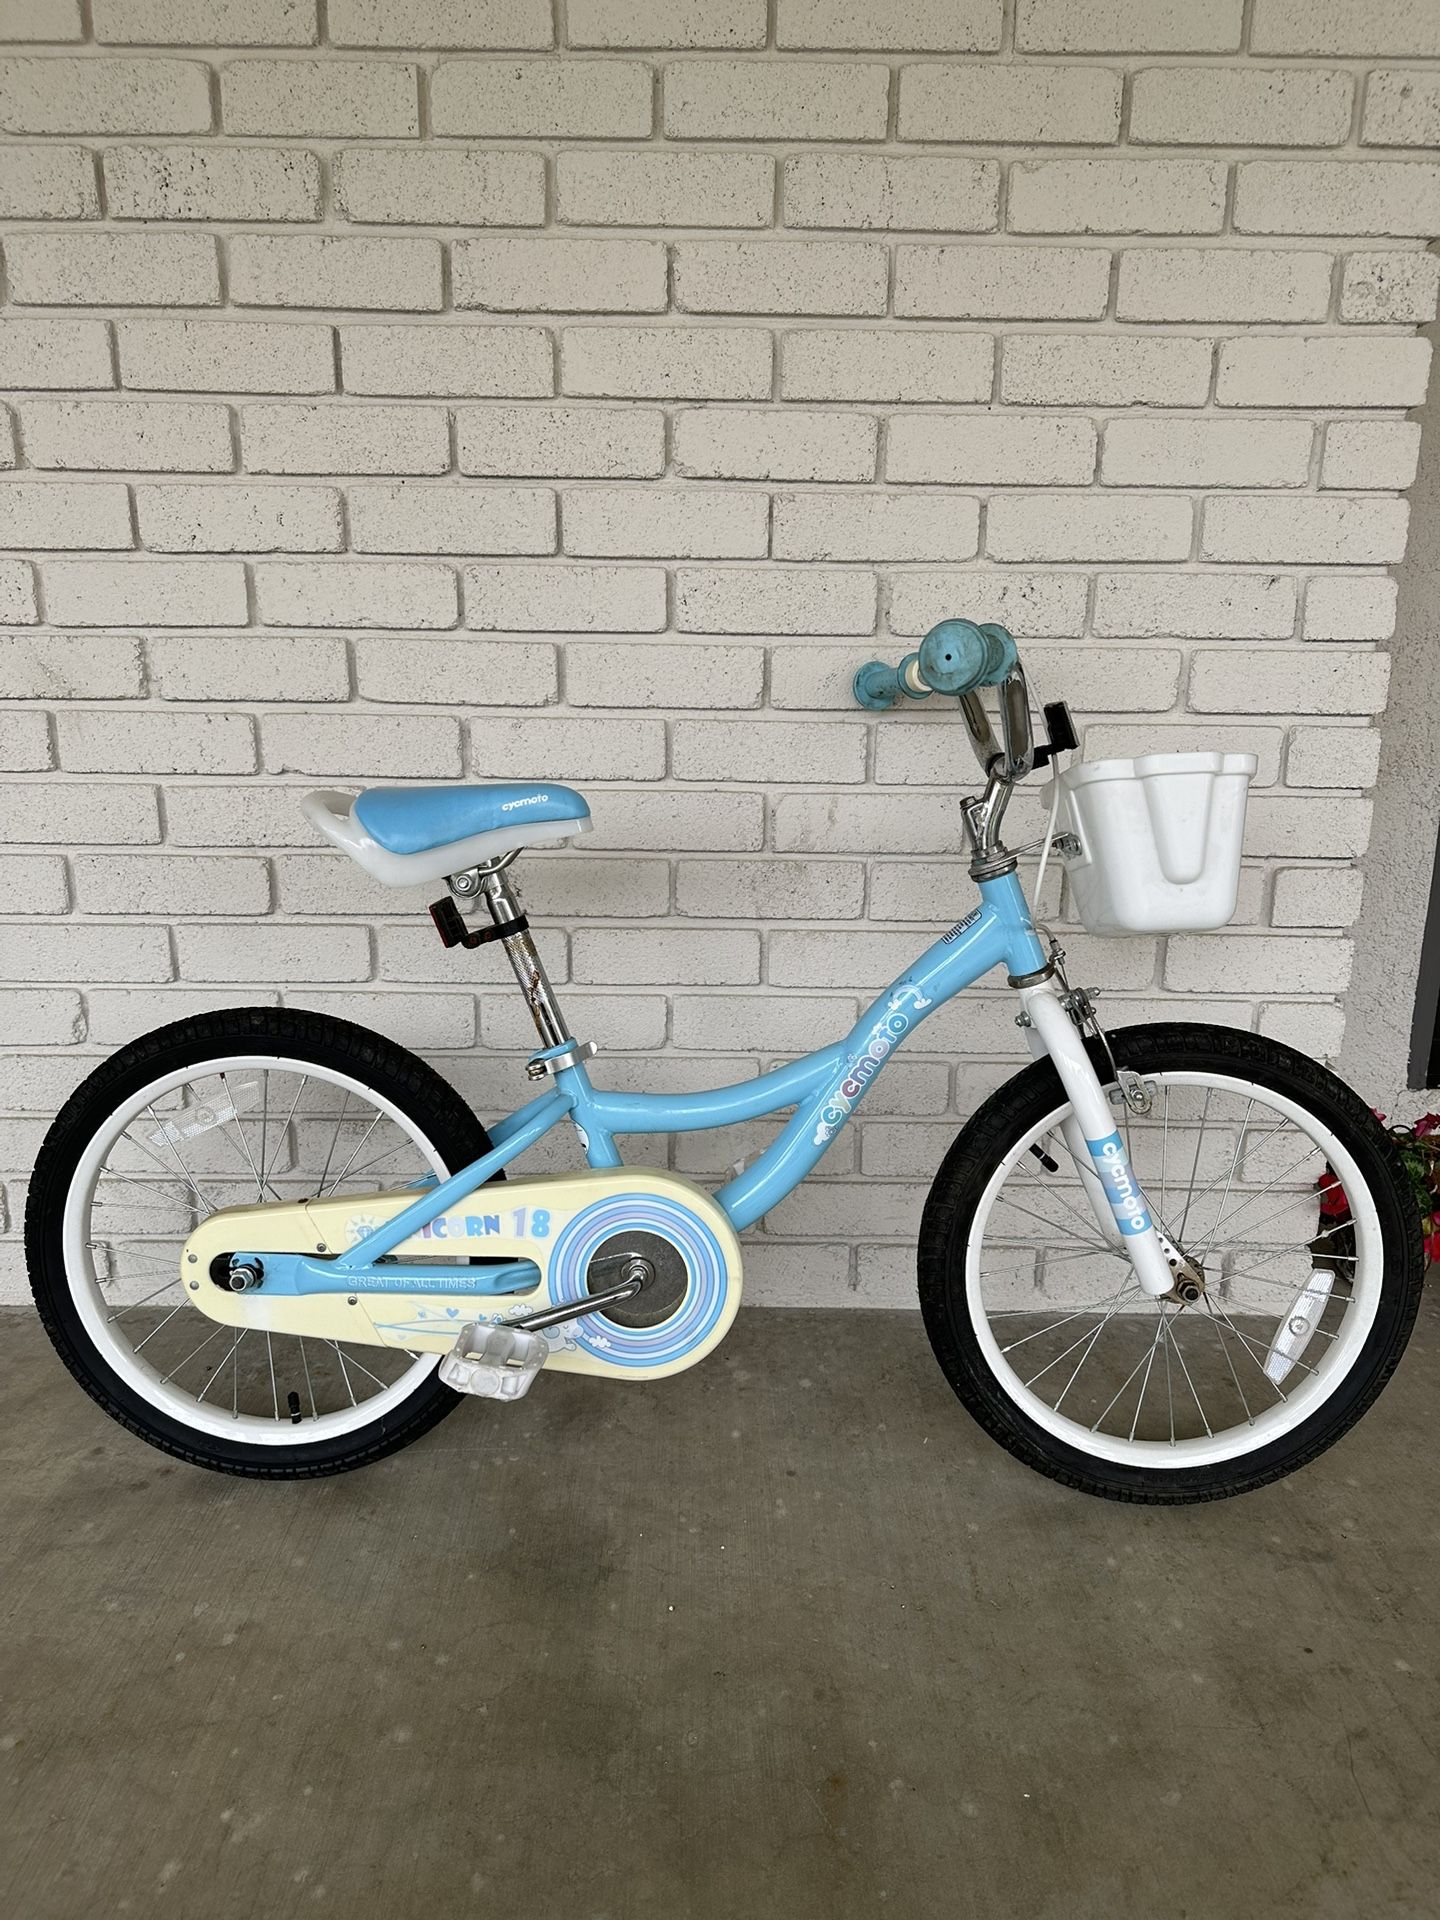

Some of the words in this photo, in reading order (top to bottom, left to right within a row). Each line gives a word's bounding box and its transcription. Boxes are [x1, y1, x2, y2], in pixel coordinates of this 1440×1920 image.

[502, 794, 549, 812] cycmoto
[820, 1013, 909, 1127] cycmoto
[1103, 1142, 1145, 1230] cycmoto
[512, 1207, 551, 1238] 18
[347, 1276, 389, 1288] GREAT
[394, 1277, 410, 1289] OF
[411, 1277, 435, 1289] ALL
[438, 1277, 477, 1289] TIMES
